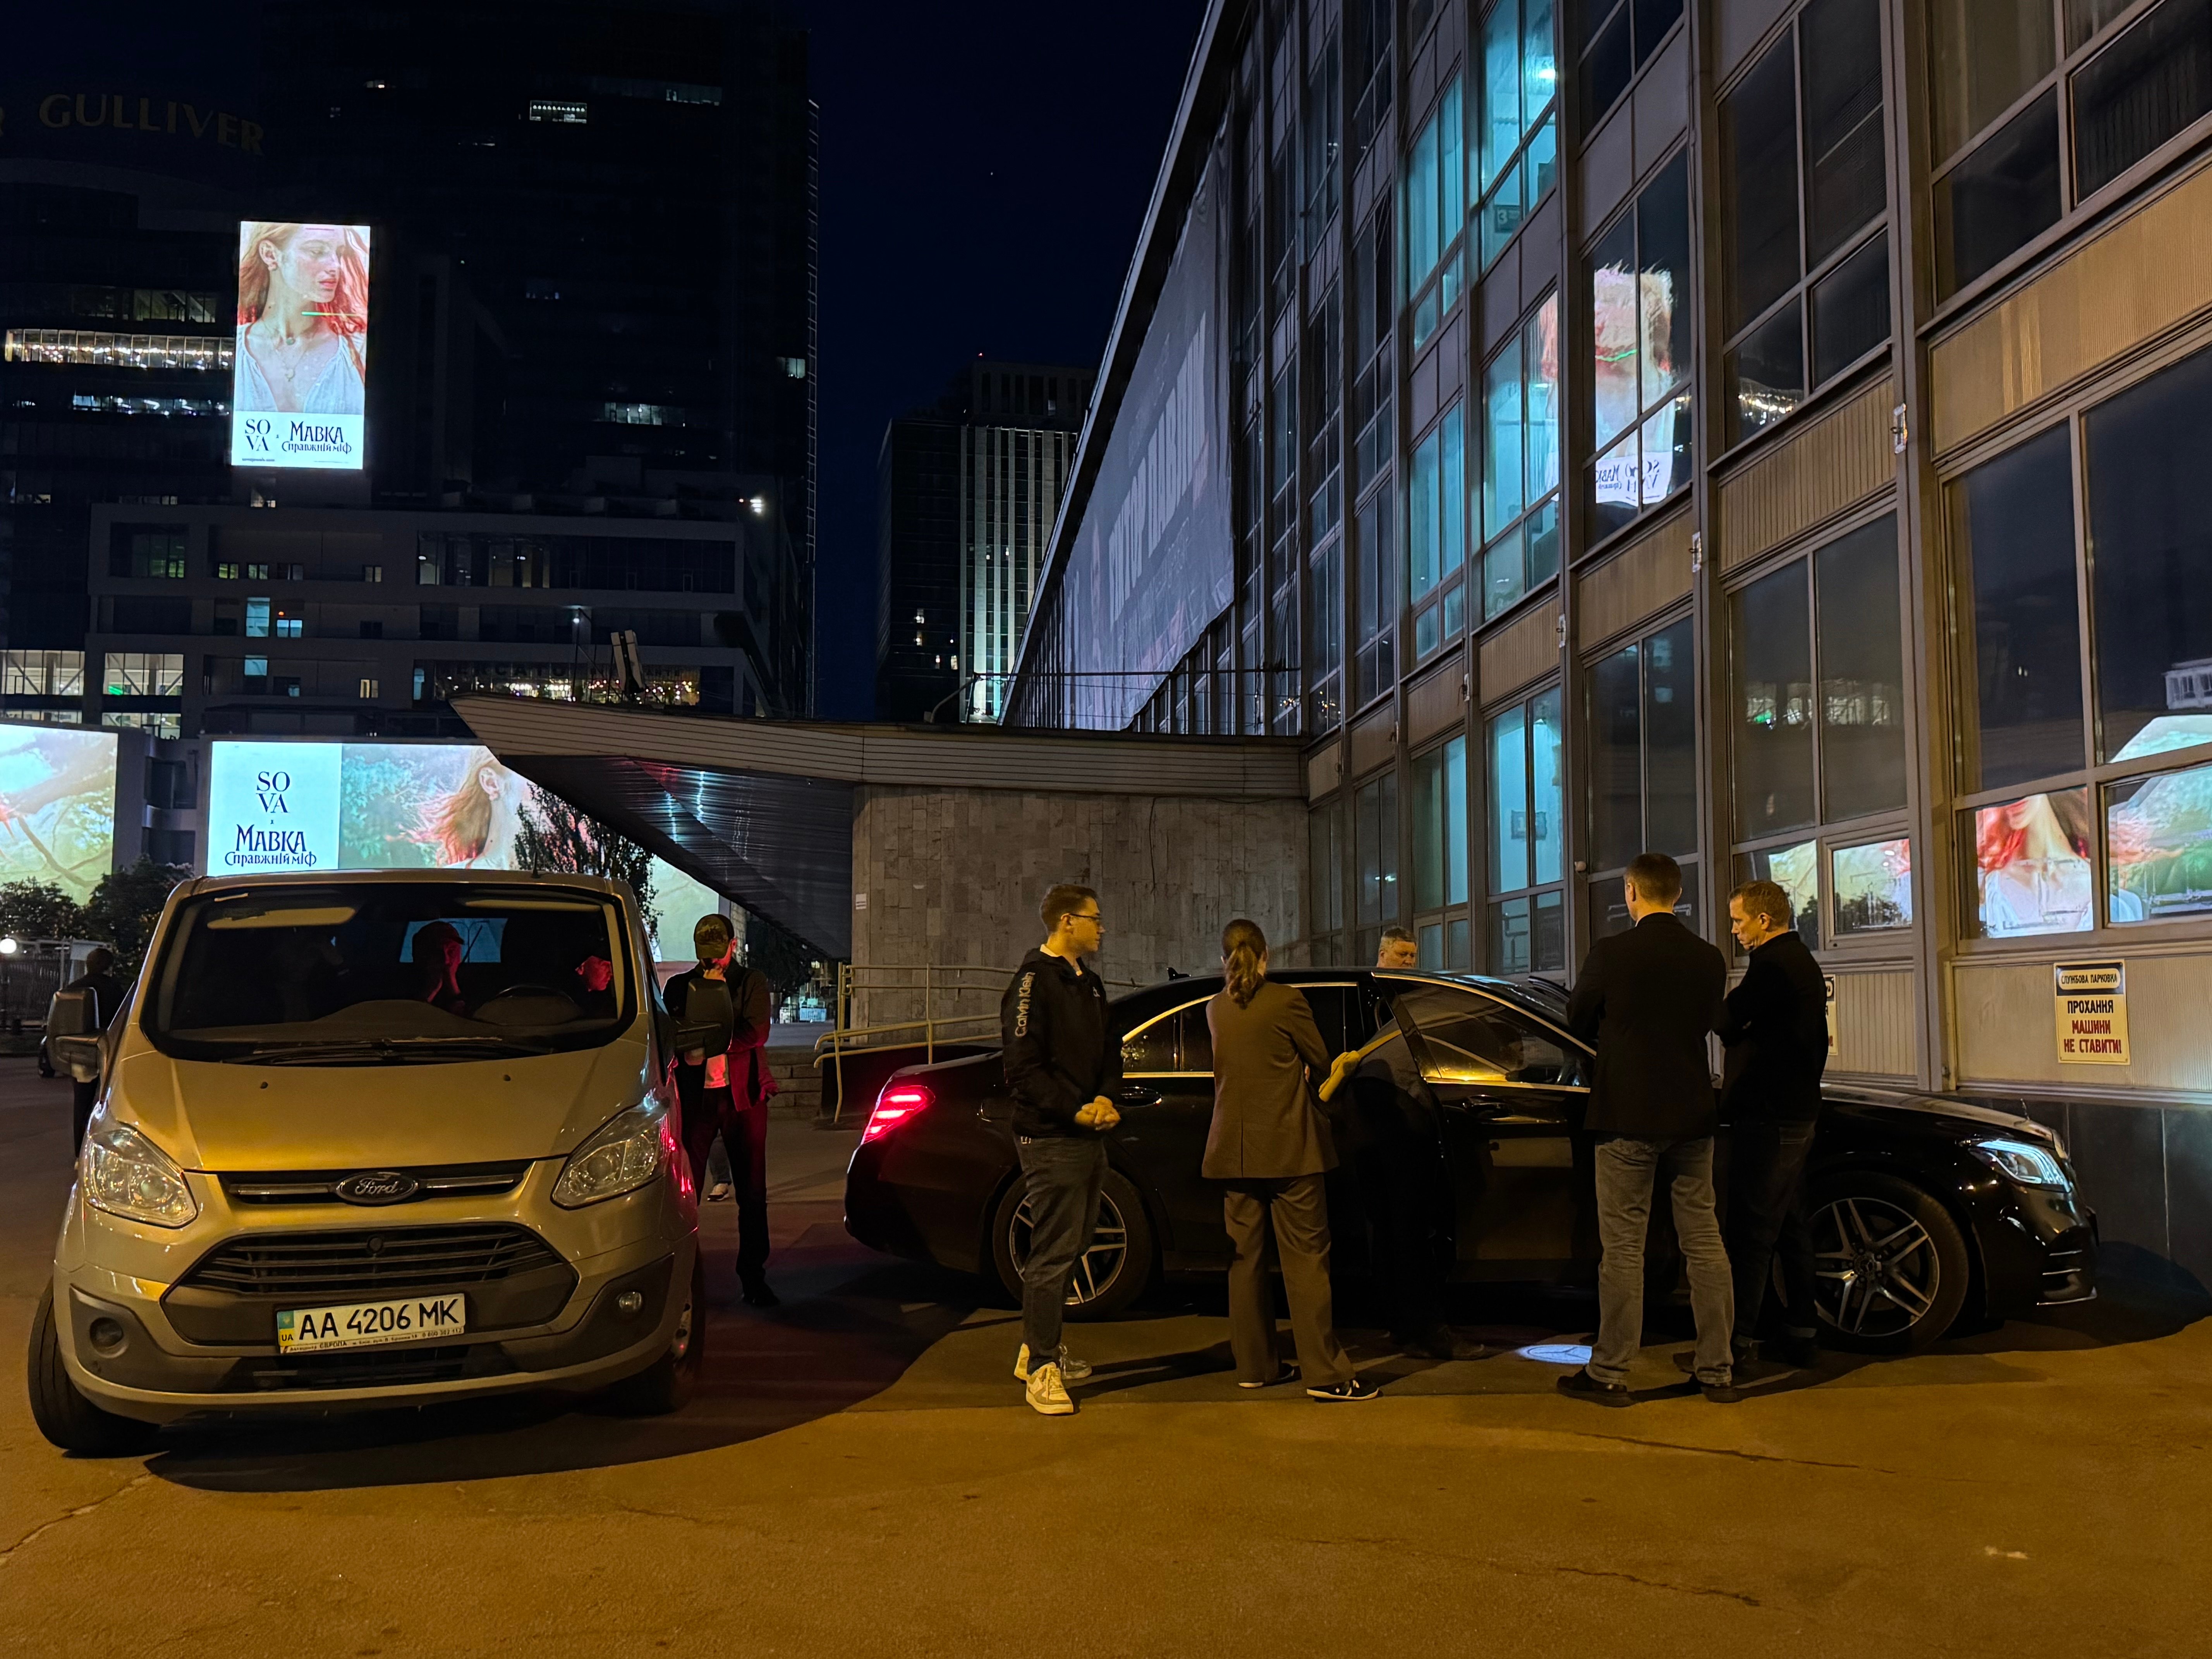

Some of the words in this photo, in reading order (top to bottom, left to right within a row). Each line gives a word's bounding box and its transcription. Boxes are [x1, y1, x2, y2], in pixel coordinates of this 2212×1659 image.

[39, 94, 264, 156] GULLIVER
[245, 419, 271, 434] SO
[244, 435, 270, 451] VA
[256, 771, 290, 792] SO
[256, 793, 290, 813] VA
[2061, 974, 2089, 984] СЛУЖБОВА
[2090, 973, 2118, 983] ПАРКОВКА
[2067, 1000, 2114, 1014] ПРОХАННЯ
[1015, 998, 1031, 1037] Calvin
[2072, 1020, 2111, 1034] МАШИНИ
[2064, 1038, 2075, 1053] НЕ
[355, 1178, 399, 1195] Ford
[299, 1312, 339, 1340] AA
[347, 1304, 411, 1335] 4206
[419, 1298, 459, 1328] MK
